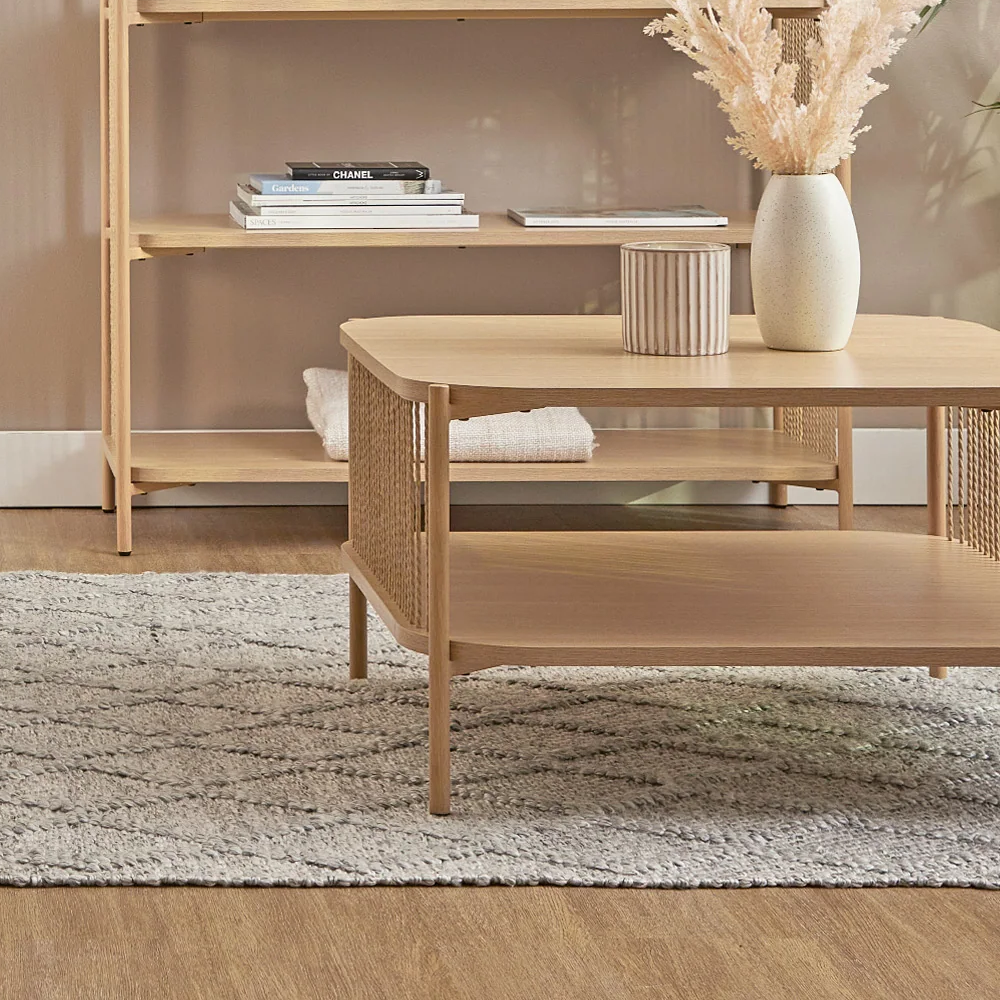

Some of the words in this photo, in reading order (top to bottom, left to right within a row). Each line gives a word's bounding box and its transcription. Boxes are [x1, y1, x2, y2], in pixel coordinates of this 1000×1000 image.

[332, 170, 374, 179] CHANEL
[271, 183, 309, 193] Gardens
[250, 218, 277, 226] SPACES
